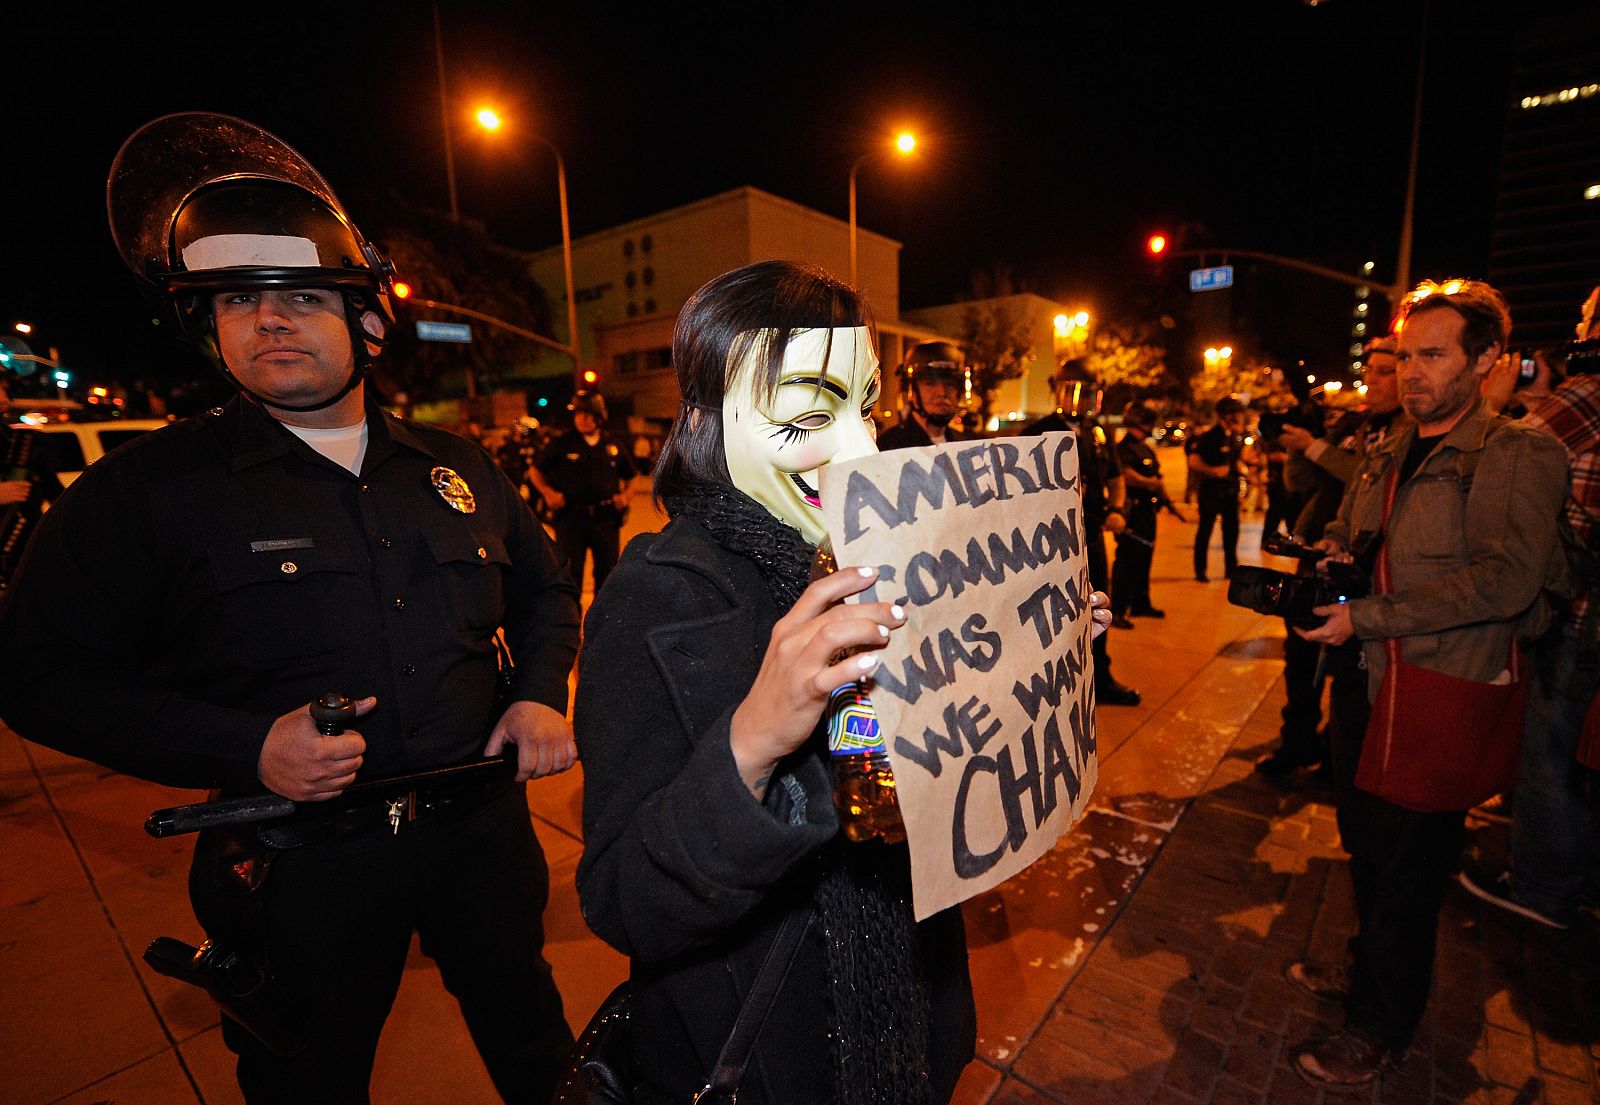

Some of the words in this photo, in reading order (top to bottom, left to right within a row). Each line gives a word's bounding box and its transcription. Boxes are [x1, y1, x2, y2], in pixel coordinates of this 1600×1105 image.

[843, 436, 1080, 545] AMERIC
[871, 613, 1002, 705] WAS
[1017, 570, 1087, 650] TAK
[894, 695, 1002, 778] WE
[952, 674, 1097, 879] CHANG
